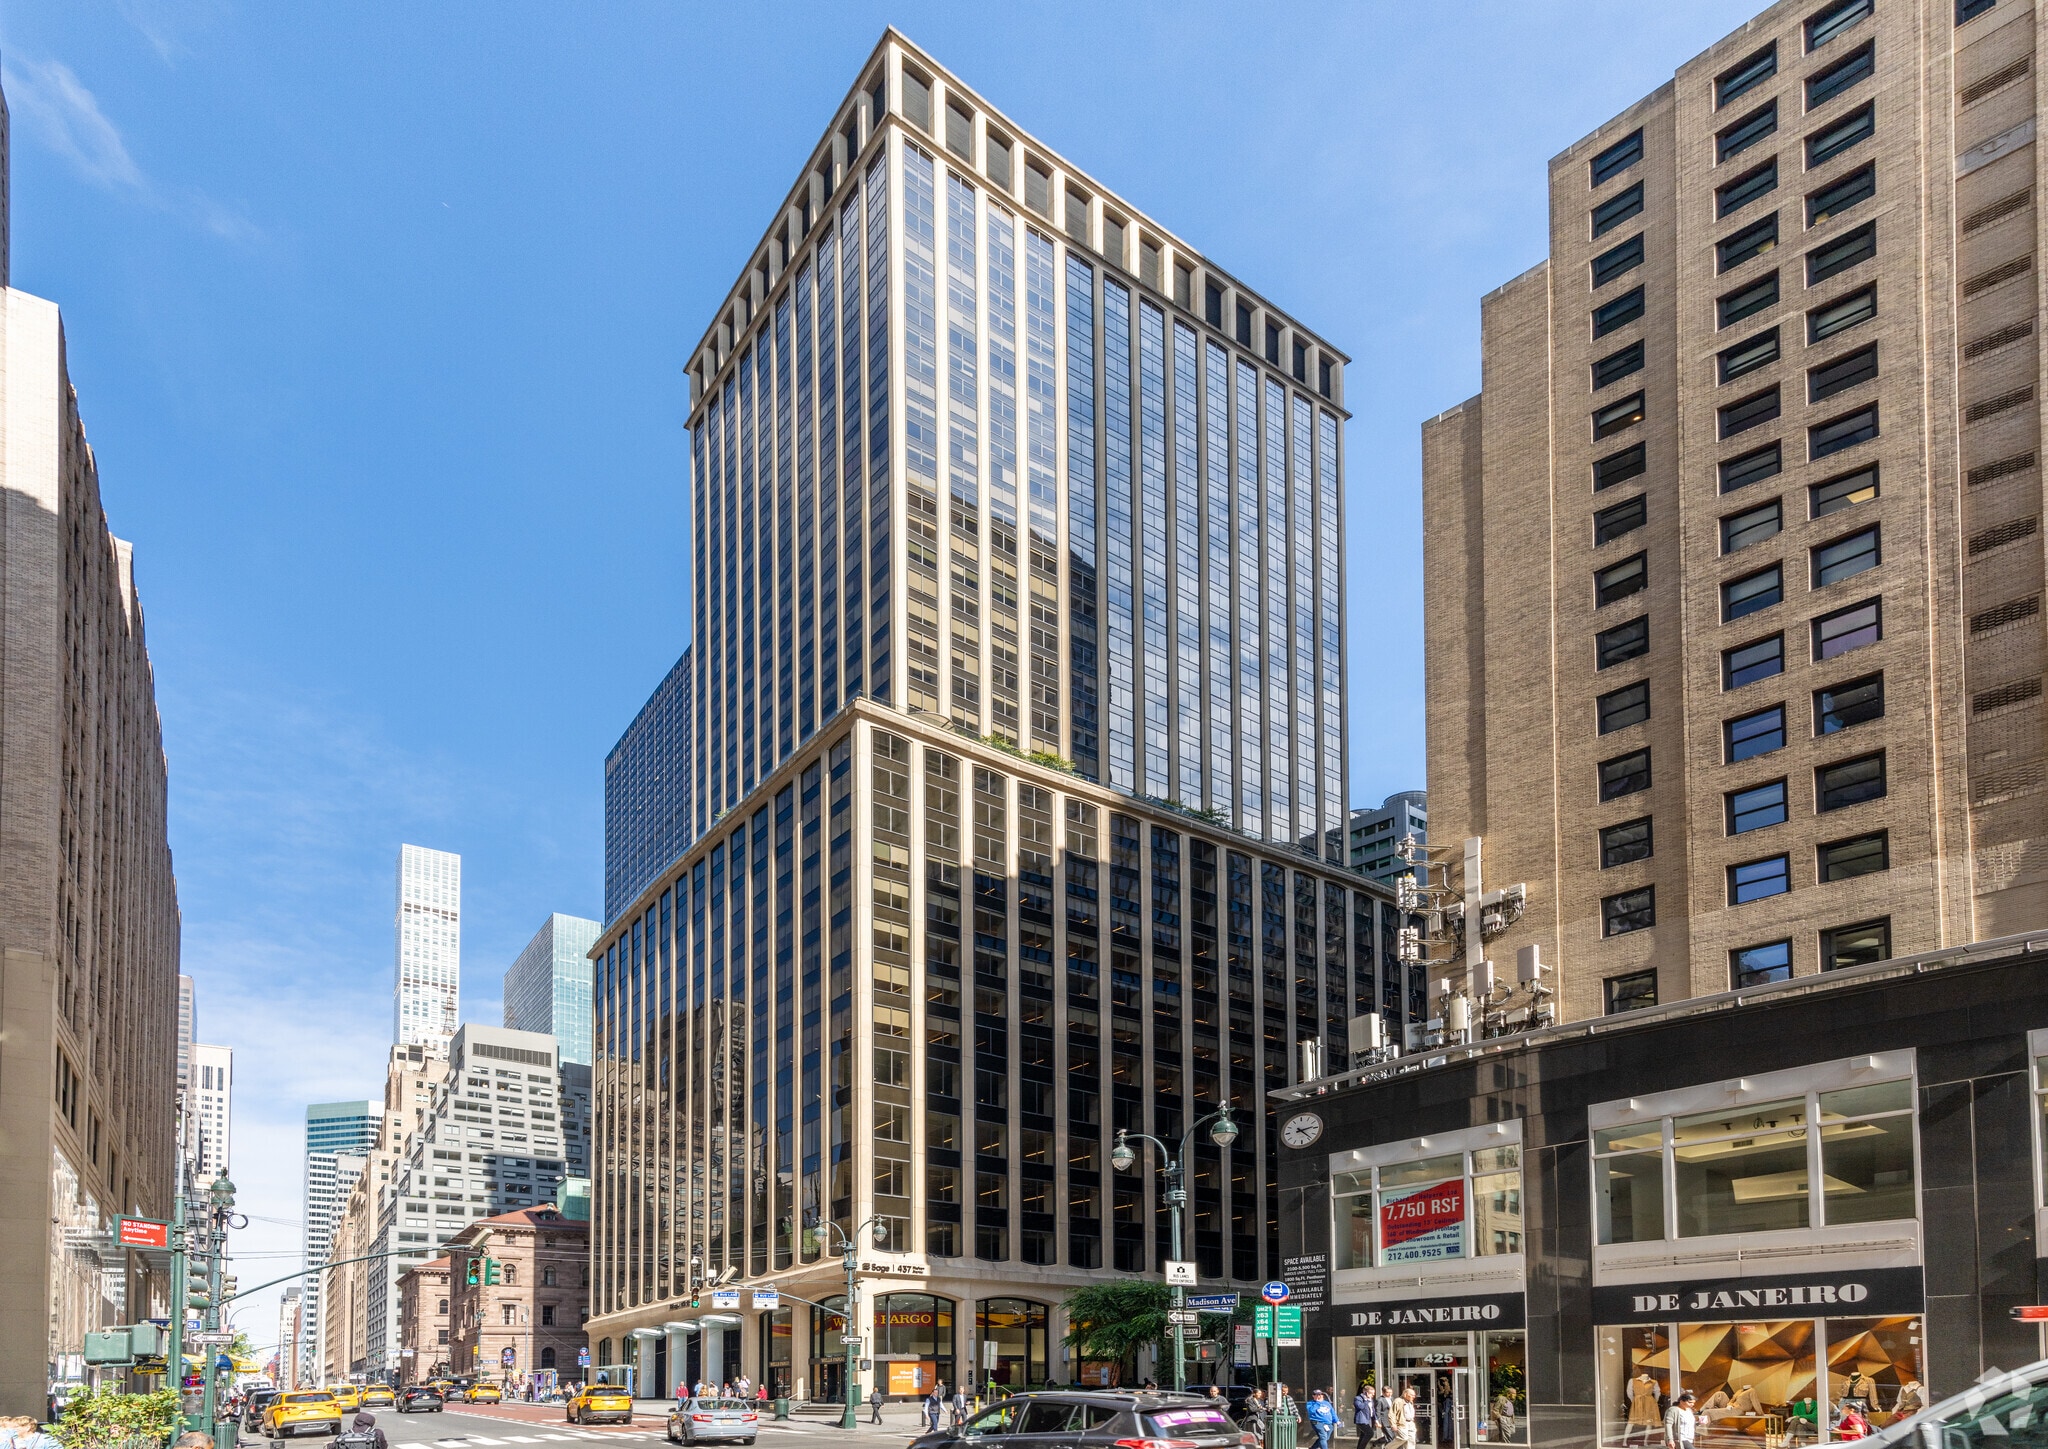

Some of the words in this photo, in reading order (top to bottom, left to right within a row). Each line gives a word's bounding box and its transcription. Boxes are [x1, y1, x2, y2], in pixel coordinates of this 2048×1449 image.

[1386, 1201, 1425, 1220] 7,750
[1431, 1197, 1460, 1215] RSF
[123, 1226, 148, 1234] Anytime
[133, 1222, 161, 1230] STANDING
[1300, 1255, 1325, 1263] AVAILABLE
[1388, 1248, 1442, 1261] 212.400.9525
[871, 1263, 890, 1273] Sage
[897, 1265, 912, 1273] 437
[1187, 1298, 1220, 1306] Madison
[1632, 1293, 1680, 1312] DE
[1690, 1283, 1867, 1310] JANEIRO
[1351, 1311, 1382, 1326] DE
[1388, 1304, 1500, 1325] JANEIRO
[188, 1321, 197, 1329] St
[1424, 1353, 1454, 1363] 425
